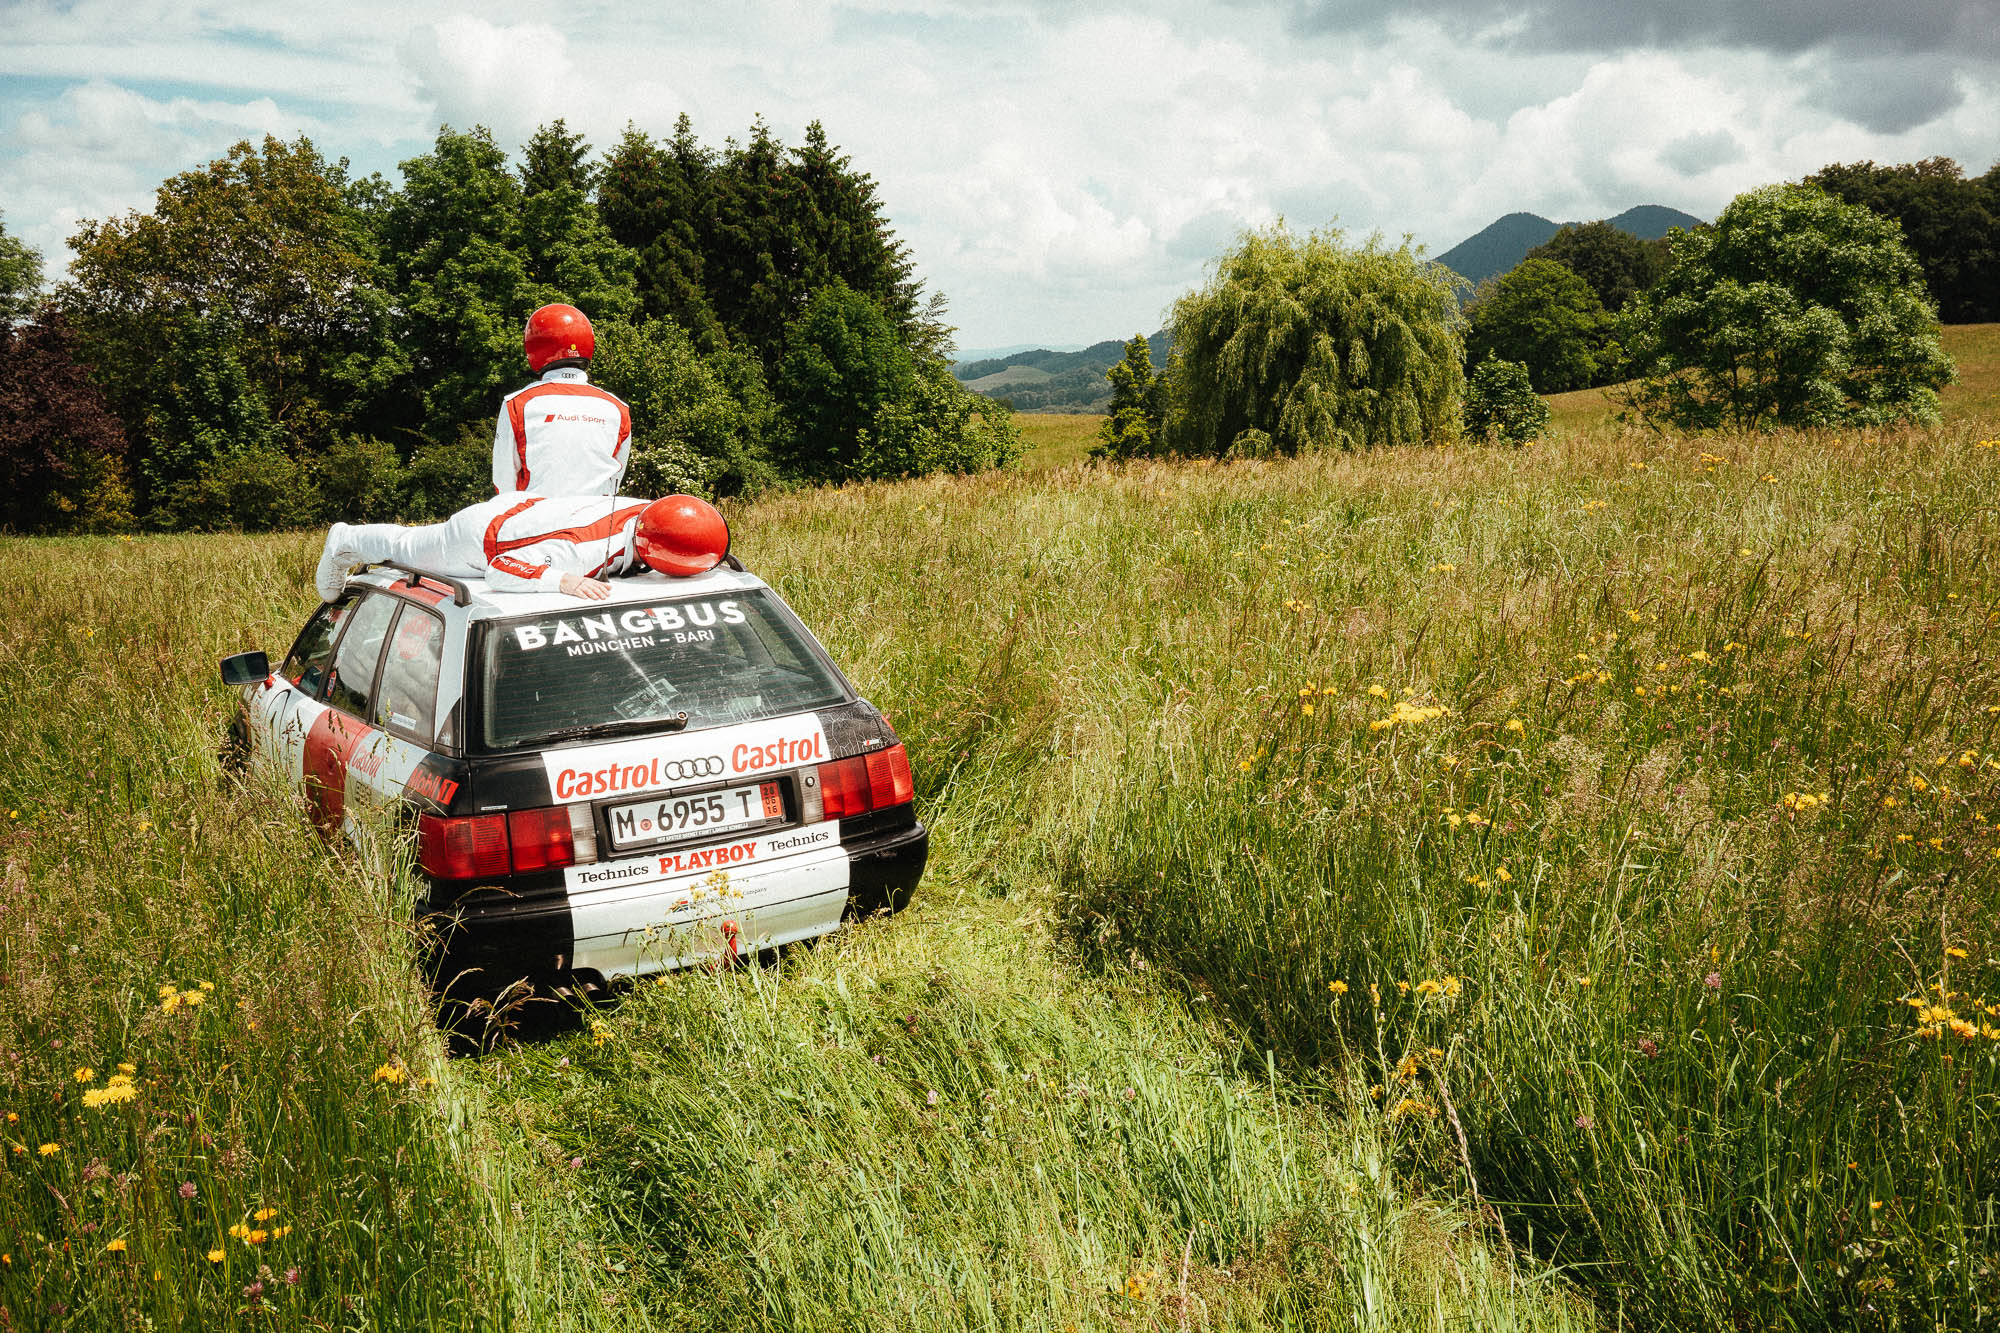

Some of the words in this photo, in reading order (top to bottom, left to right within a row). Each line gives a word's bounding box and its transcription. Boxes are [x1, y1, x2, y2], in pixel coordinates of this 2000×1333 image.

[556, 413, 580, 421] Audi
[582, 415, 606, 424] Sport
[566, 636, 655, 657] MÜNCHEN
[674, 630, 715, 644] BARI
[351, 746, 384, 778] Castrol
[556, 758, 661, 799] Castrol
[731, 732, 823, 773] Castrol
[408, 768, 441, 800] Mobil
[616, 808, 637, 838] M
[656, 795, 725, 832] 6955
[736, 790, 752, 818] T
[577, 864, 649, 884] Technics
[659, 842, 757, 874] PLAYBOY
[768, 831, 829, 852] Technics
